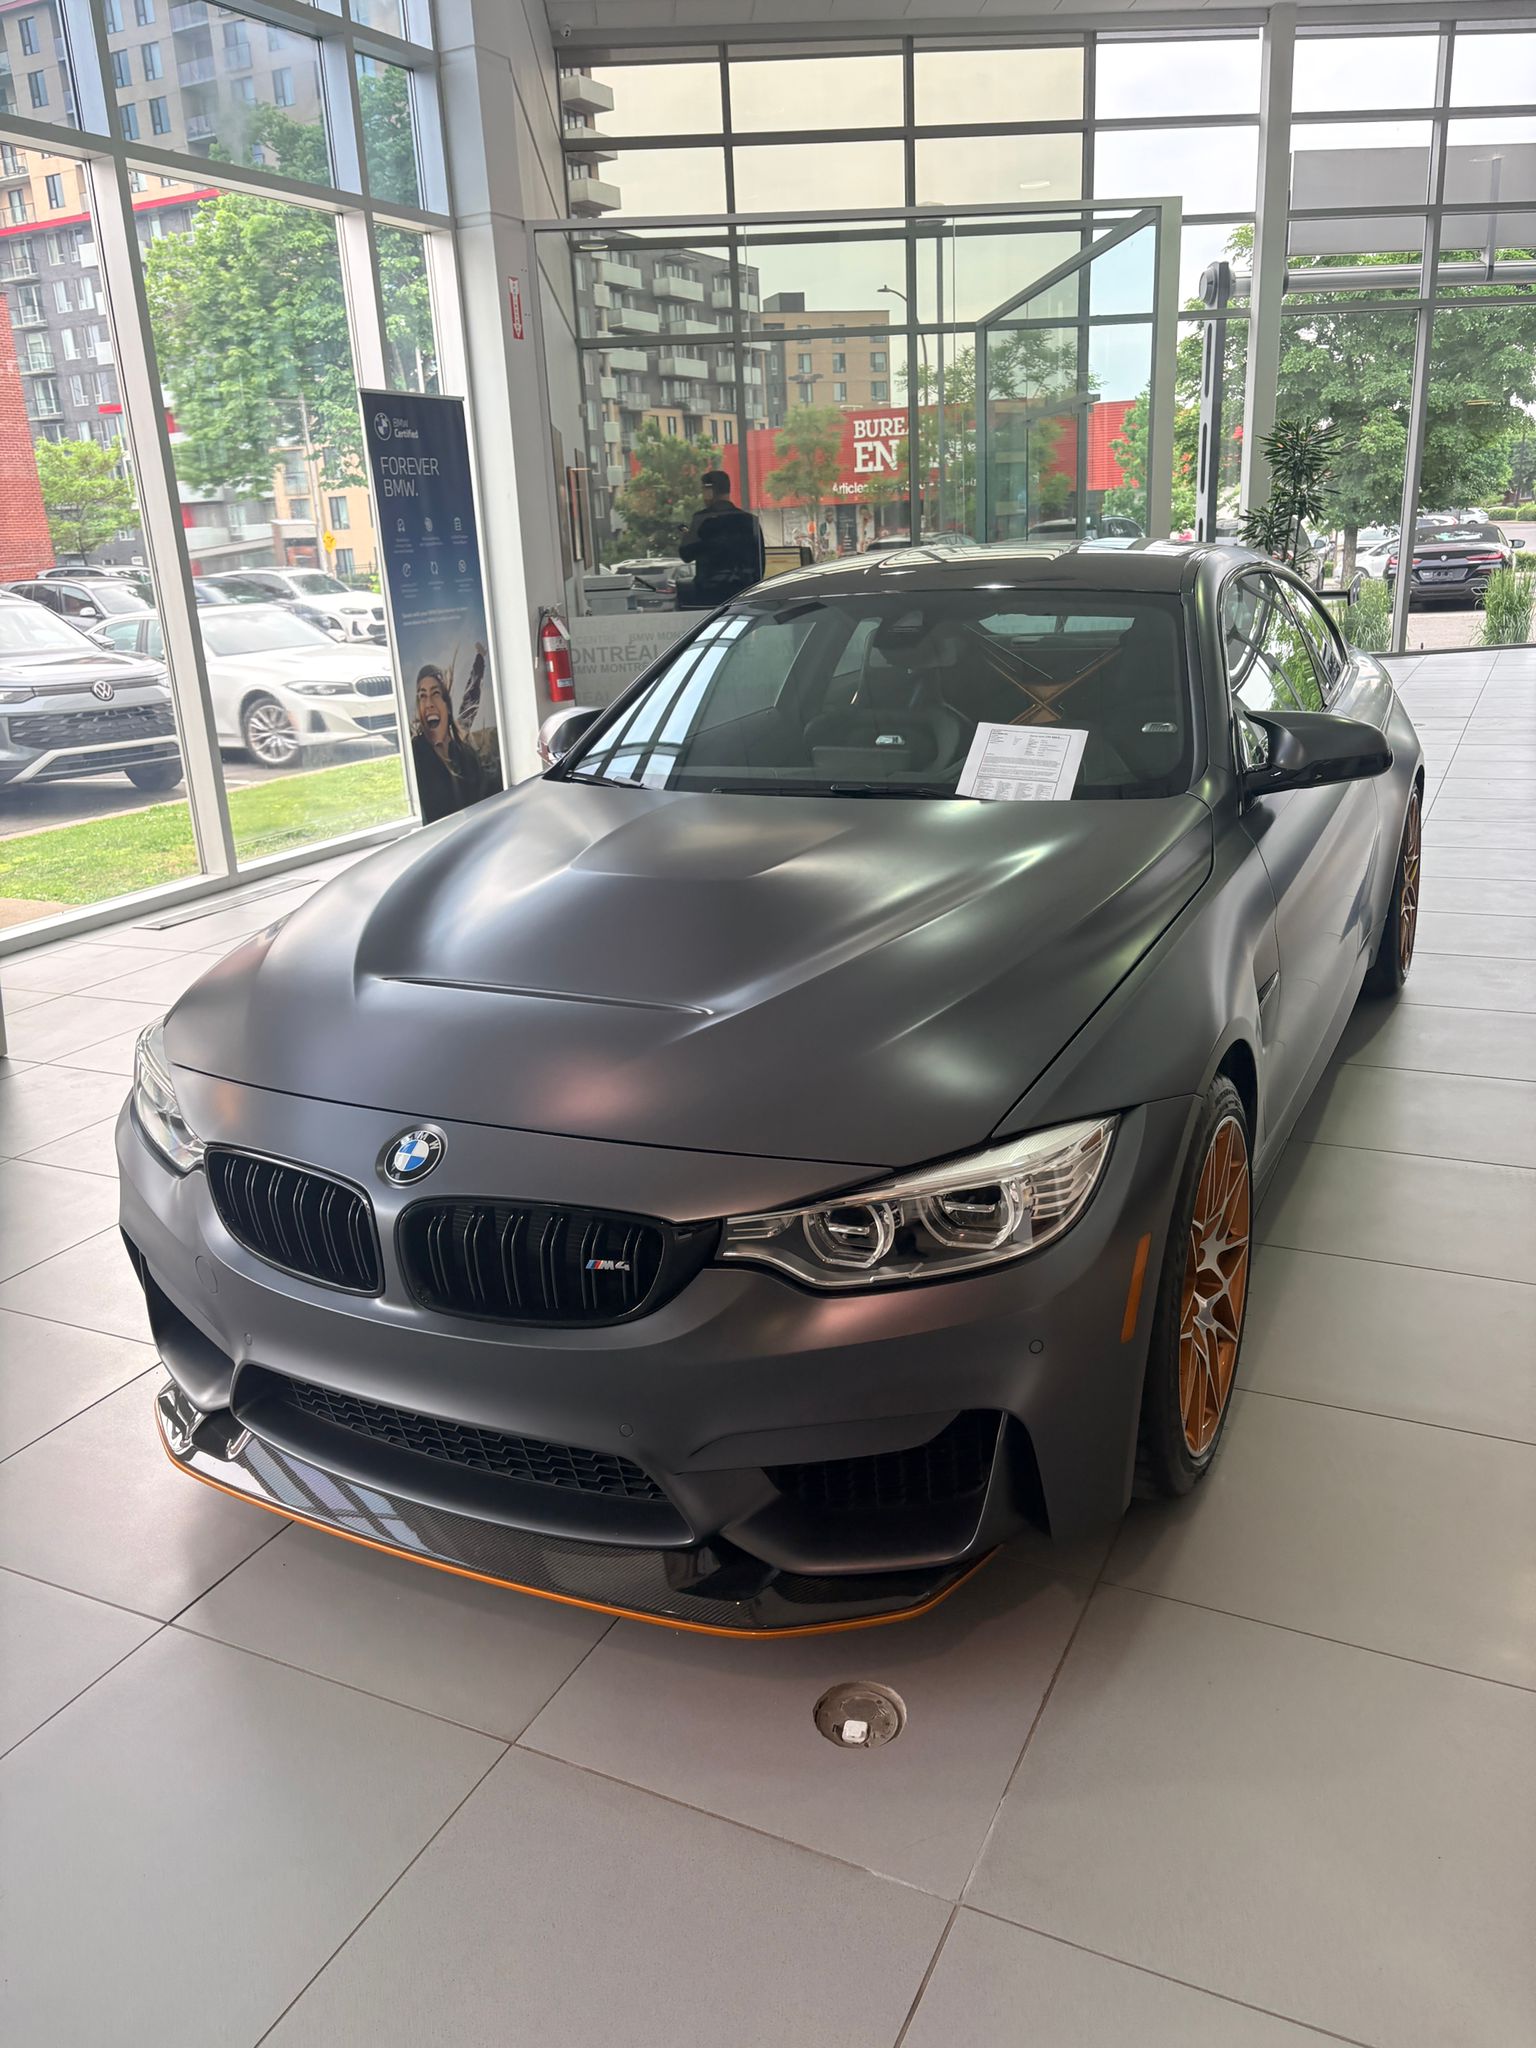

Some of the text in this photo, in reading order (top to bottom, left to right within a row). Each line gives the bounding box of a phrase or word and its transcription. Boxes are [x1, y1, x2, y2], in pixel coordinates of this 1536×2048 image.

[853, 416, 909, 439] BURE
[380, 456, 440, 476] FOREVER
[853, 439, 900, 474] EN
[383, 479, 419, 497] BMW.
